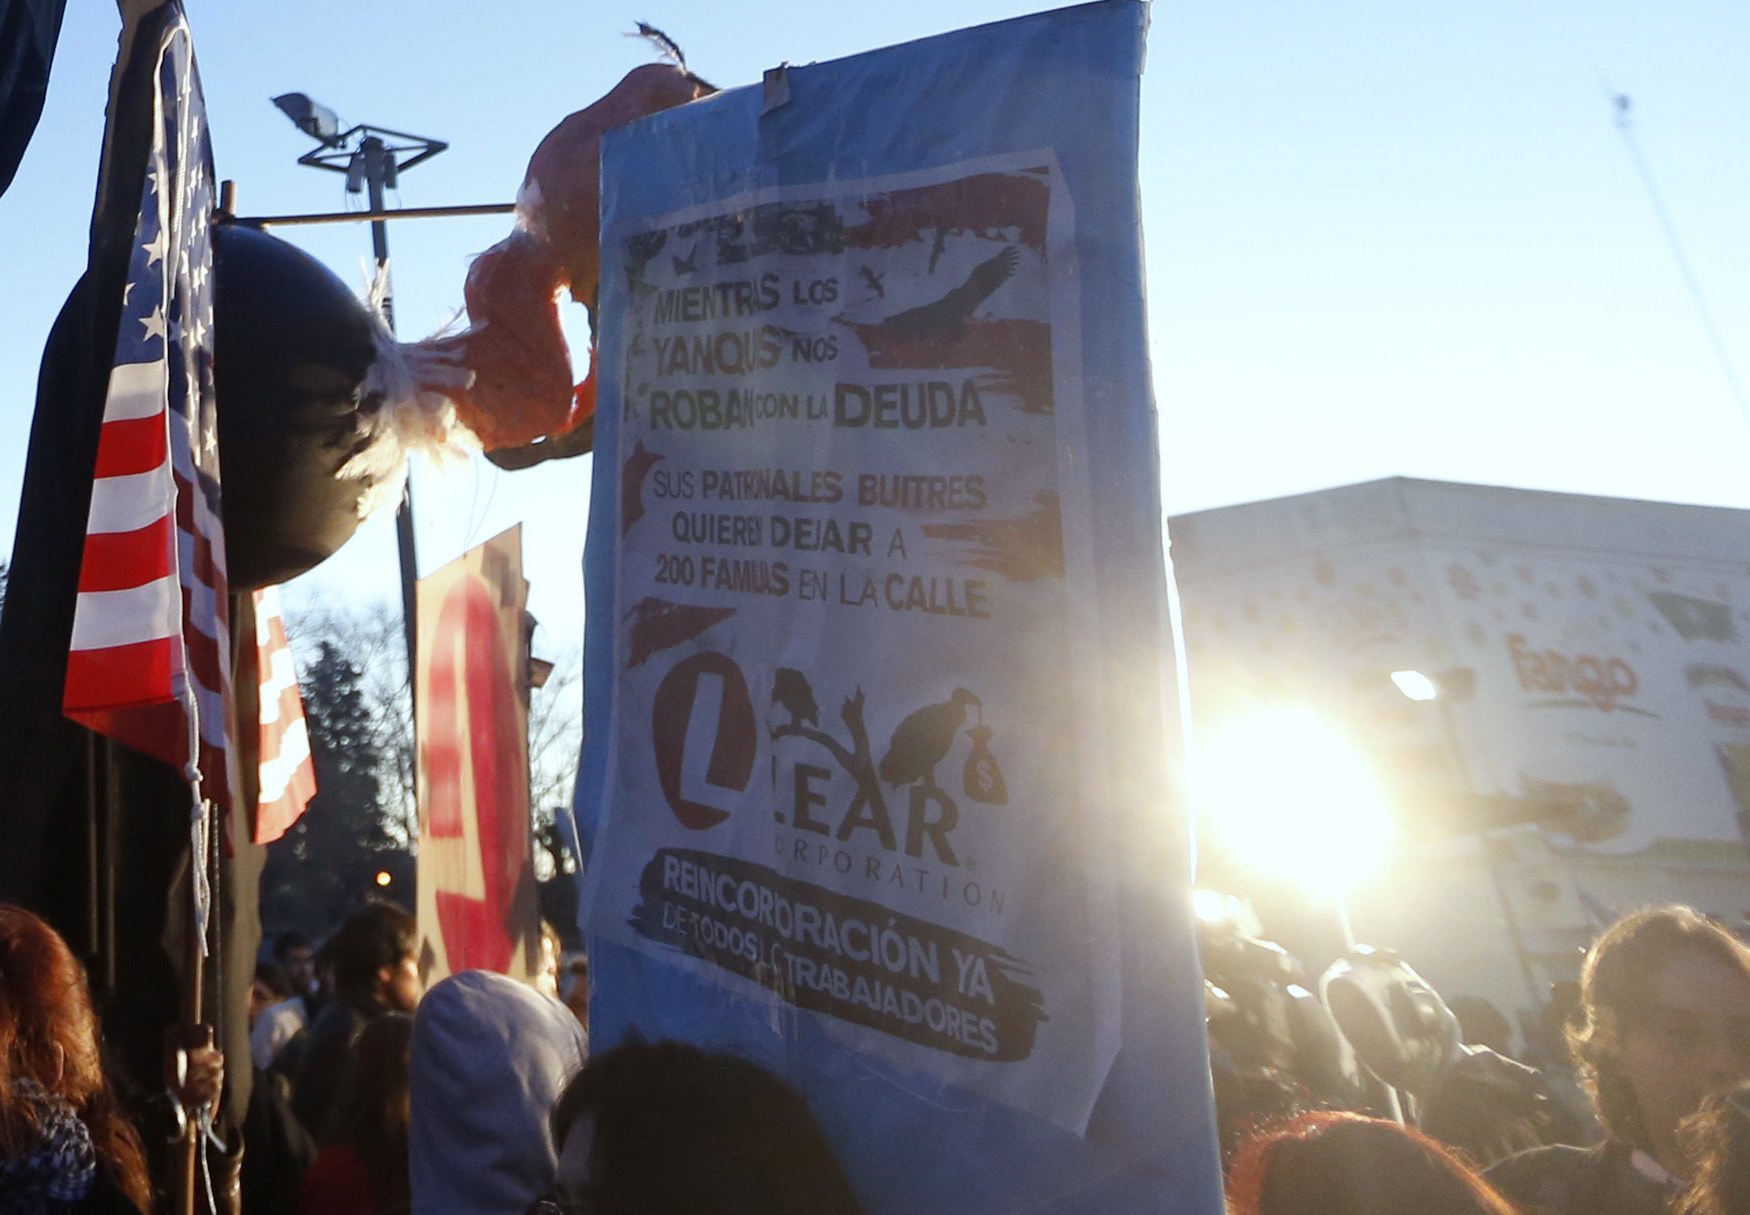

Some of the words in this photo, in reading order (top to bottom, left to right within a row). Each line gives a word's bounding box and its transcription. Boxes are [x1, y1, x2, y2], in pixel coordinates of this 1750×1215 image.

[793, 278, 839, 305] LOS
[792, 334, 838, 364] NOS
[755, 393, 798, 419] CON
[806, 393, 828, 420] LA
[835, 379, 987, 430] DEUDA
[653, 470, 694, 500] SUS
[701, 468, 844, 504] PATRNALES
[858, 473, 987, 510] BUITRES
[886, 527, 907, 559] A
[654, 553, 695, 585] 200
[799, 569, 827, 602] EN
[840, 572, 880, 609] LA
[883, 571, 991, 620] CALLE
[773, 833, 1006, 915] ORPORATION
[663, 854, 940, 984] REINCORORACIÓN
[952, 947, 996, 1006] YA
[783, 952, 998, 1054] TRABAJADORES
